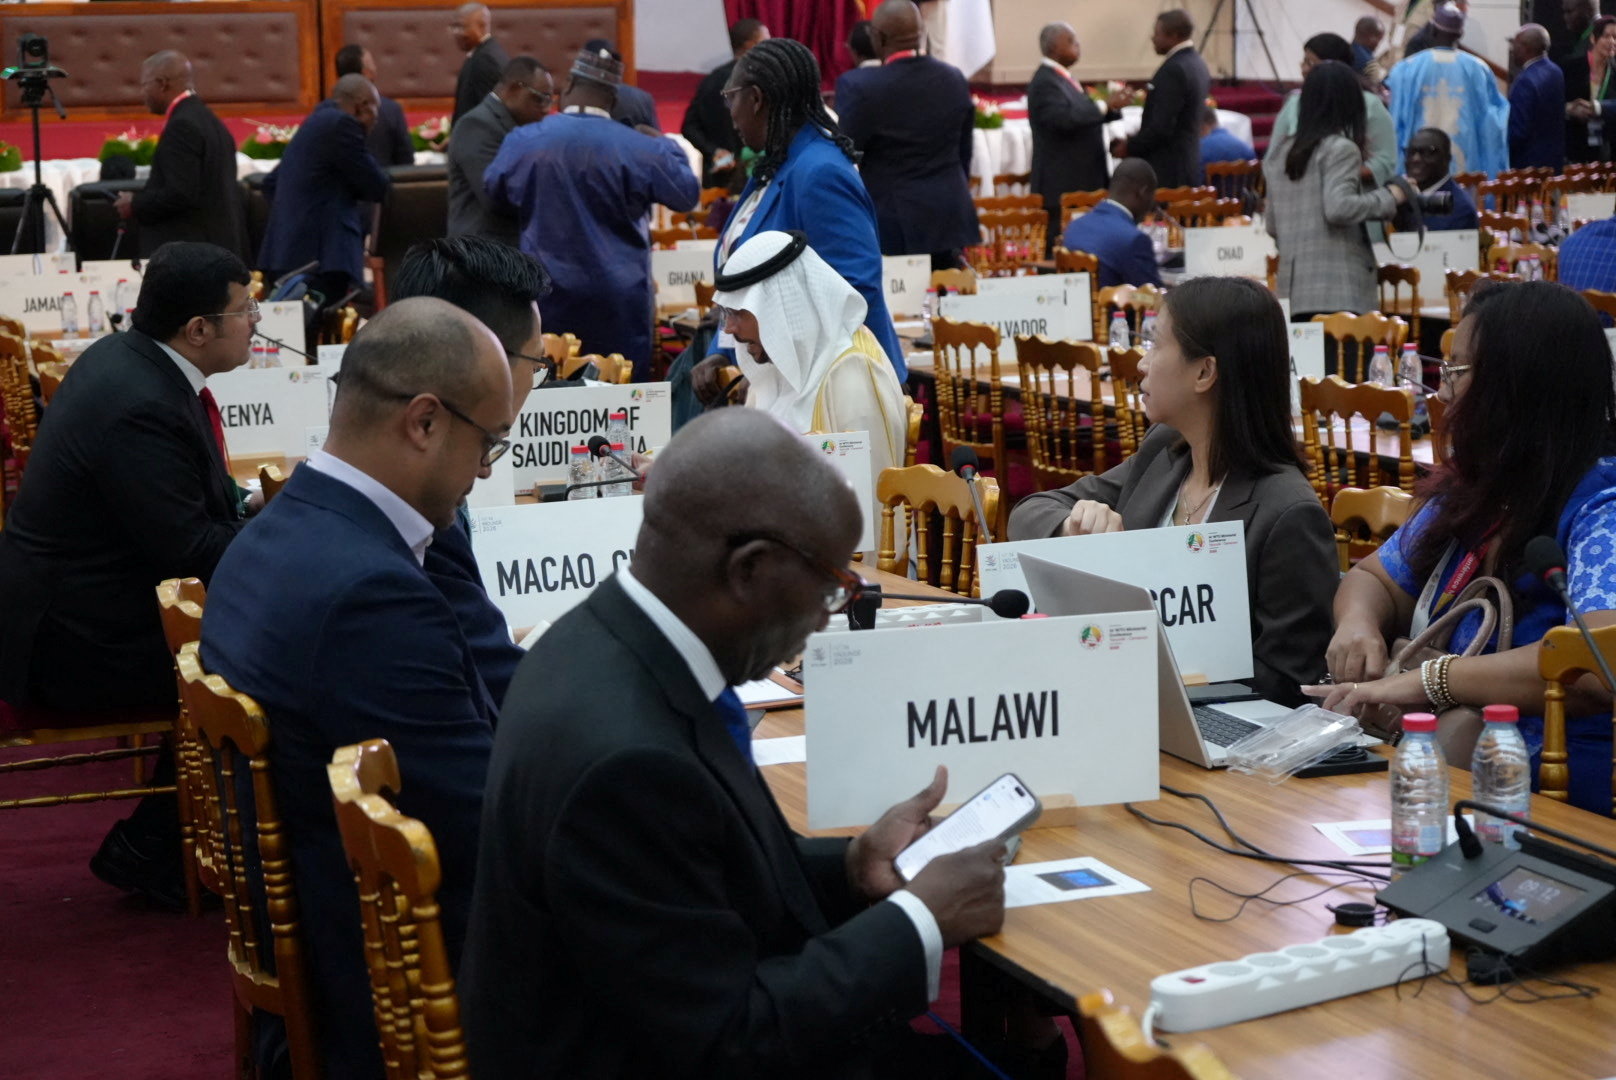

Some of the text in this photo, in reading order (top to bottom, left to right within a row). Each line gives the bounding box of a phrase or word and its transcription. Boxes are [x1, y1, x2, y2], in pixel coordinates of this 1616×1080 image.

[1217, 246, 1244, 261] CHAD
[668, 271, 705, 286] GHANA
[520, 407, 609, 438] KINGDOM
[512, 440, 569, 468] SAUDI
[496, 552, 596, 597] MACAO
[1149, 583, 1217, 627] CAR
[907, 690, 1059, 749] MALAWI
